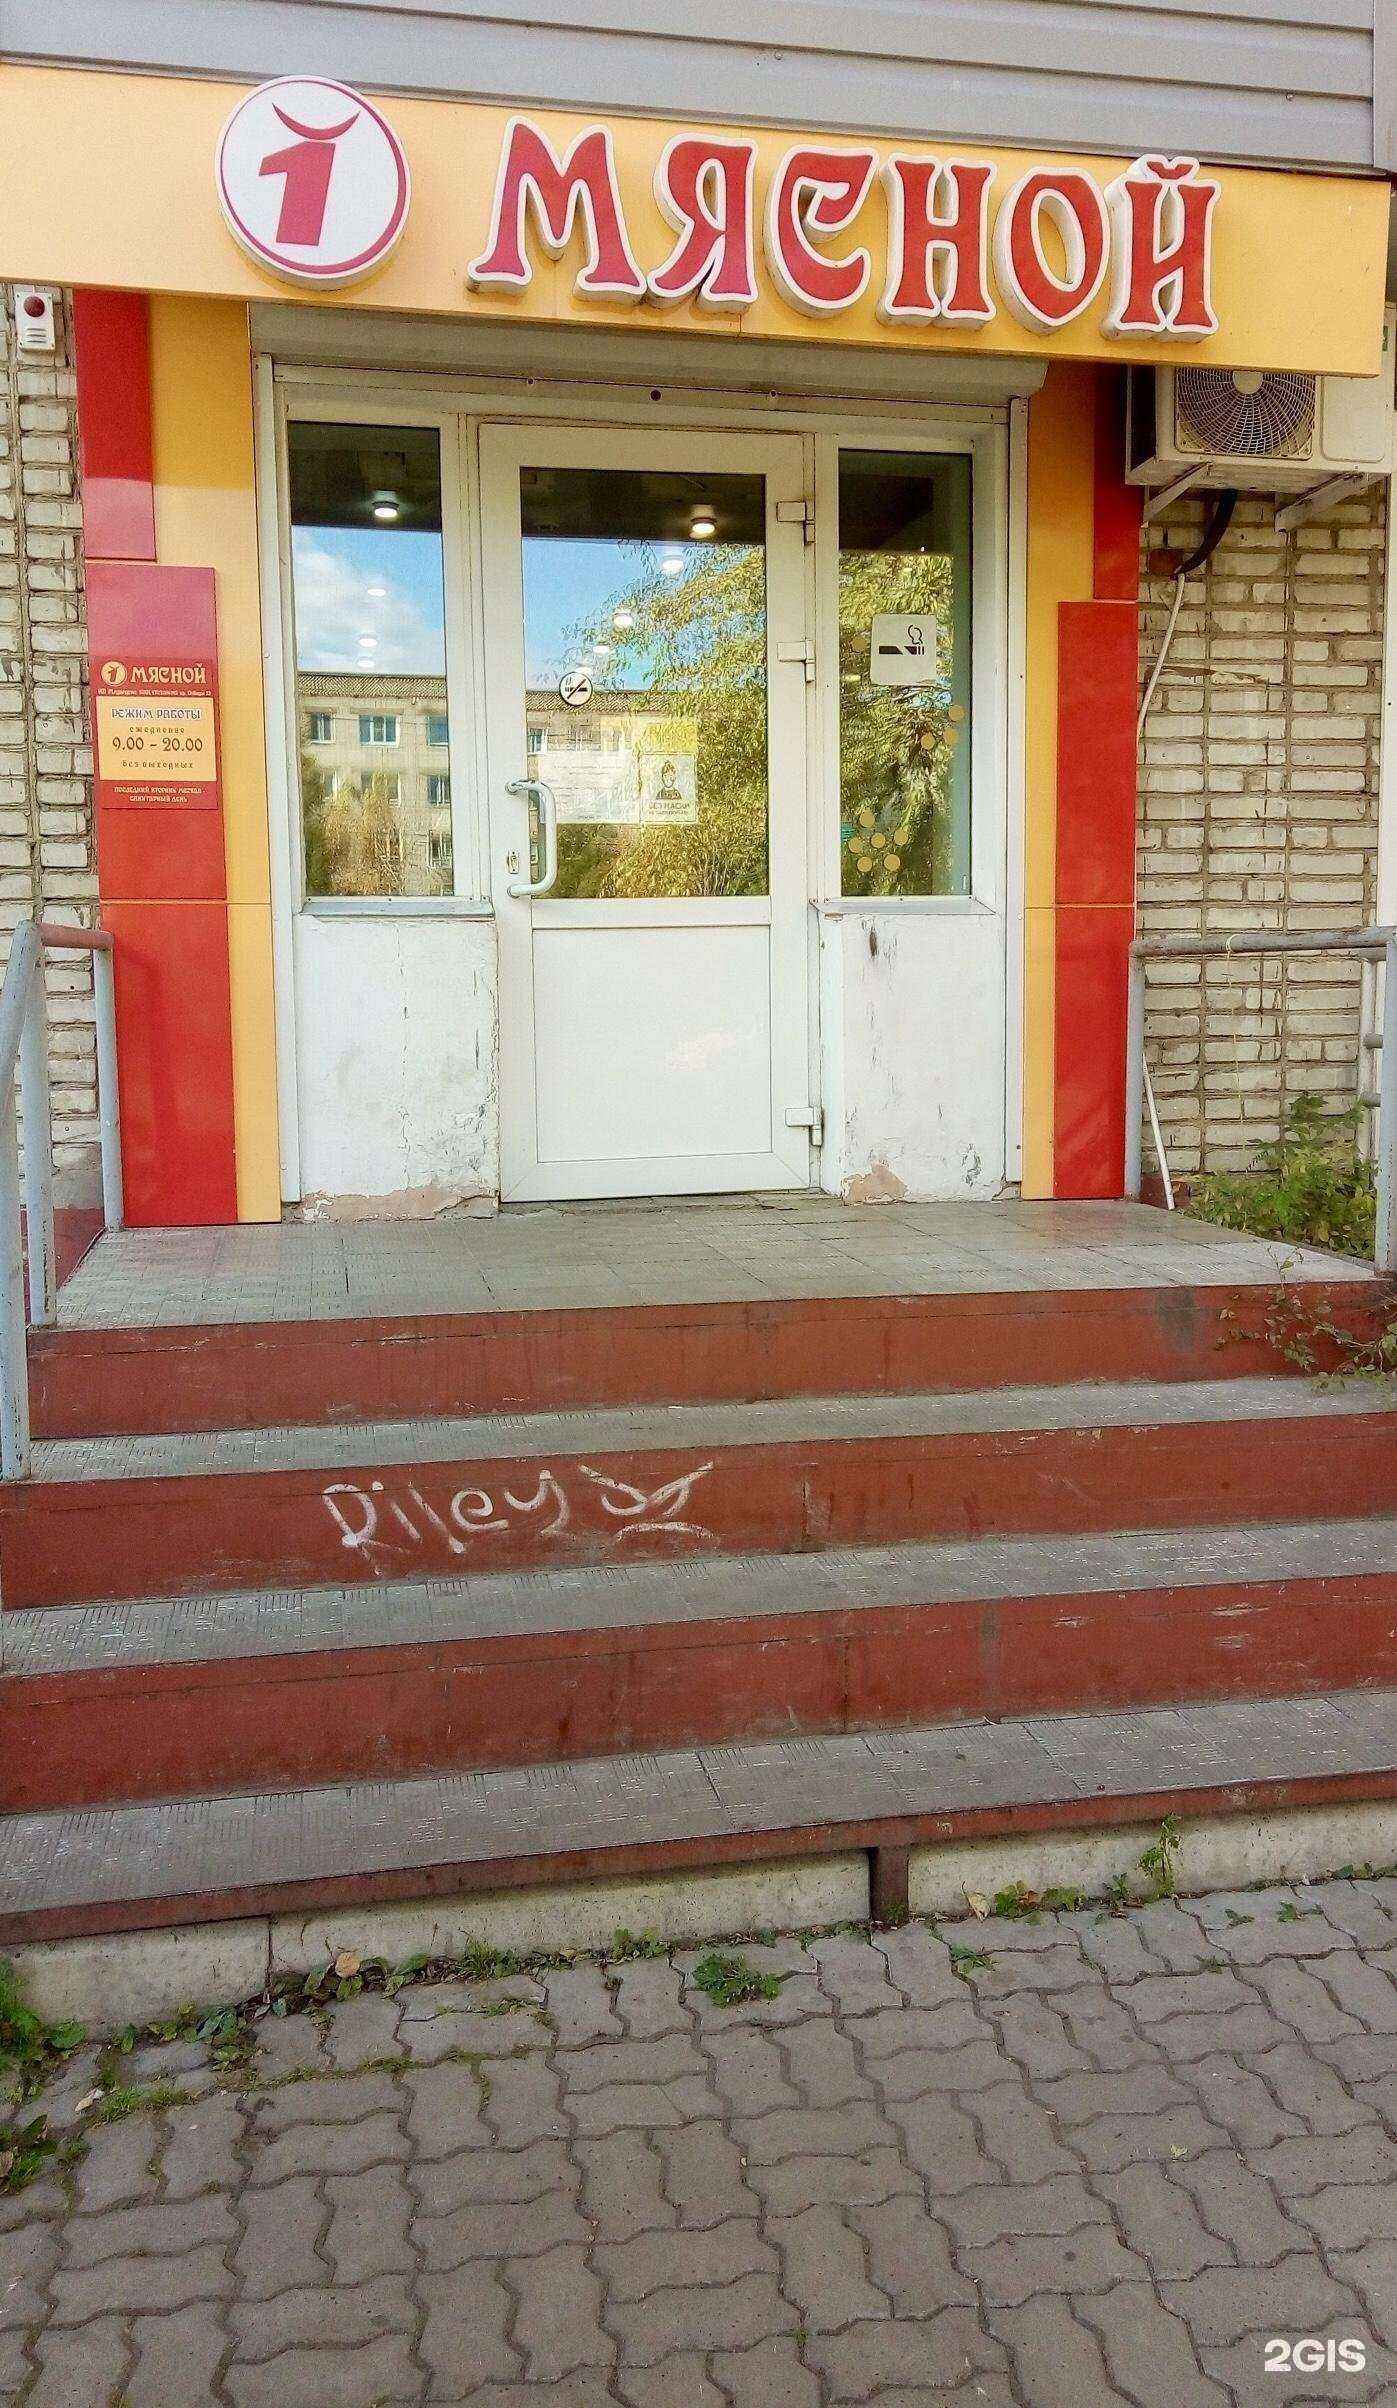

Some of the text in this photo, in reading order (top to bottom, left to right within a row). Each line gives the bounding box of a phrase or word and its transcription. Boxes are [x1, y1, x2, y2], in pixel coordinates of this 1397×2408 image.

[467, 115, 1222, 342] МЯСНОЙ
[130, 662, 207, 684] МЯСНОЙ
[111, 708, 201, 719] РЕЖИМ РАБОТЫ
[112, 736, 144, 750] 9.00
[162, 737, 203, 752] 20.00
